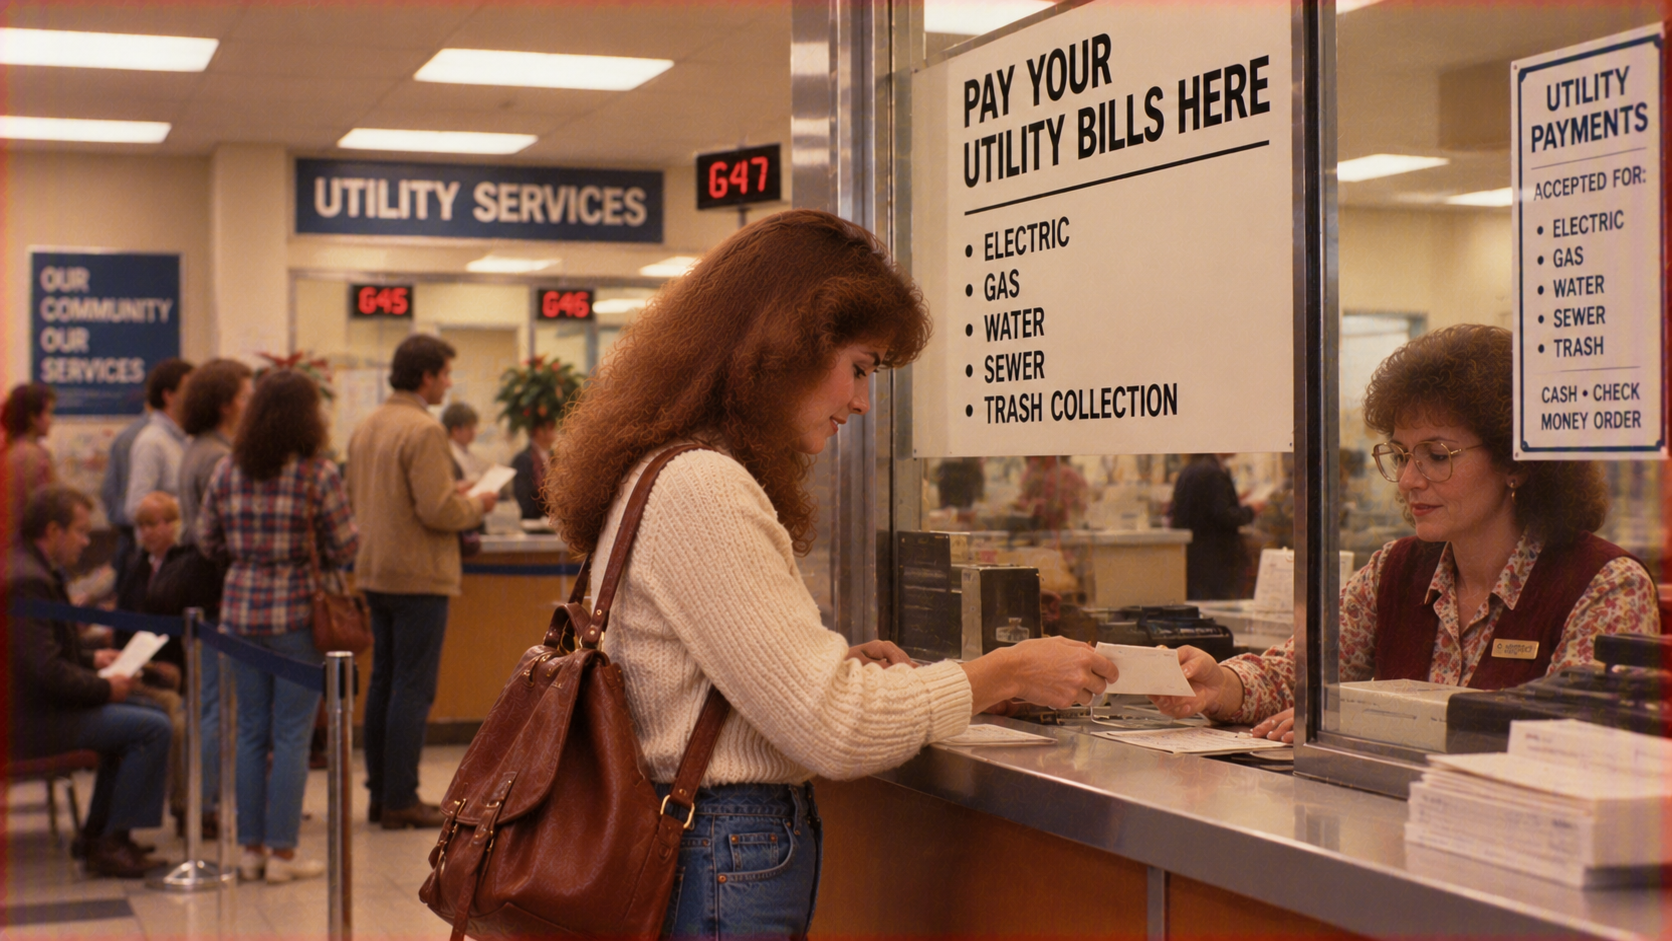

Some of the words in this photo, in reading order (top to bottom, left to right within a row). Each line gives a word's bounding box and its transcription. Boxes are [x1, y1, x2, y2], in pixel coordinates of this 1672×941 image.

[964, 64, 1015, 128] PAY
[1026, 33, 1112, 106] YOUR
[1547, 65, 1630, 111] UTILITY
[964, 113, 1066, 188] UTILITY
[1078, 86, 1164, 160] BILLS
[1178, 55, 1270, 134] HERE
[1531, 102, 1648, 153] PAYMENTS
[1534, 172, 1607, 201] ACCEPTED
[1613, 165, 1646, 188] FOR:
[314, 177, 460, 220] UTILITY
[473, 184, 648, 227] SERVICES
[984, 216, 1070, 261] ELECTRIC
[1553, 210, 1625, 238] ELECTRIC
[1553, 246, 1584, 268] GAS
[40, 266, 90, 293] OUR
[984, 269, 1020, 301] GAS
[1553, 275, 1605, 298] WATER
[40, 297, 173, 323] COMMUNITY
[984, 307, 1045, 342] WATER
[1553, 305, 1606, 328] SEWER
[40, 327, 90, 353] OUR
[1554, 336, 1604, 358] TRASH
[40, 357, 145, 383] SERVICES
[984, 350, 1045, 383] SEWER
[984, 393, 1042, 424] TRASH
[1050, 383, 1178, 421] COLLECTION
[1541, 385, 1577, 403] CASH
[1593, 382, 1640, 402] CHECK
[1541, 412, 1588, 430] MONEY
[1594, 410, 1641, 429] ORDER
